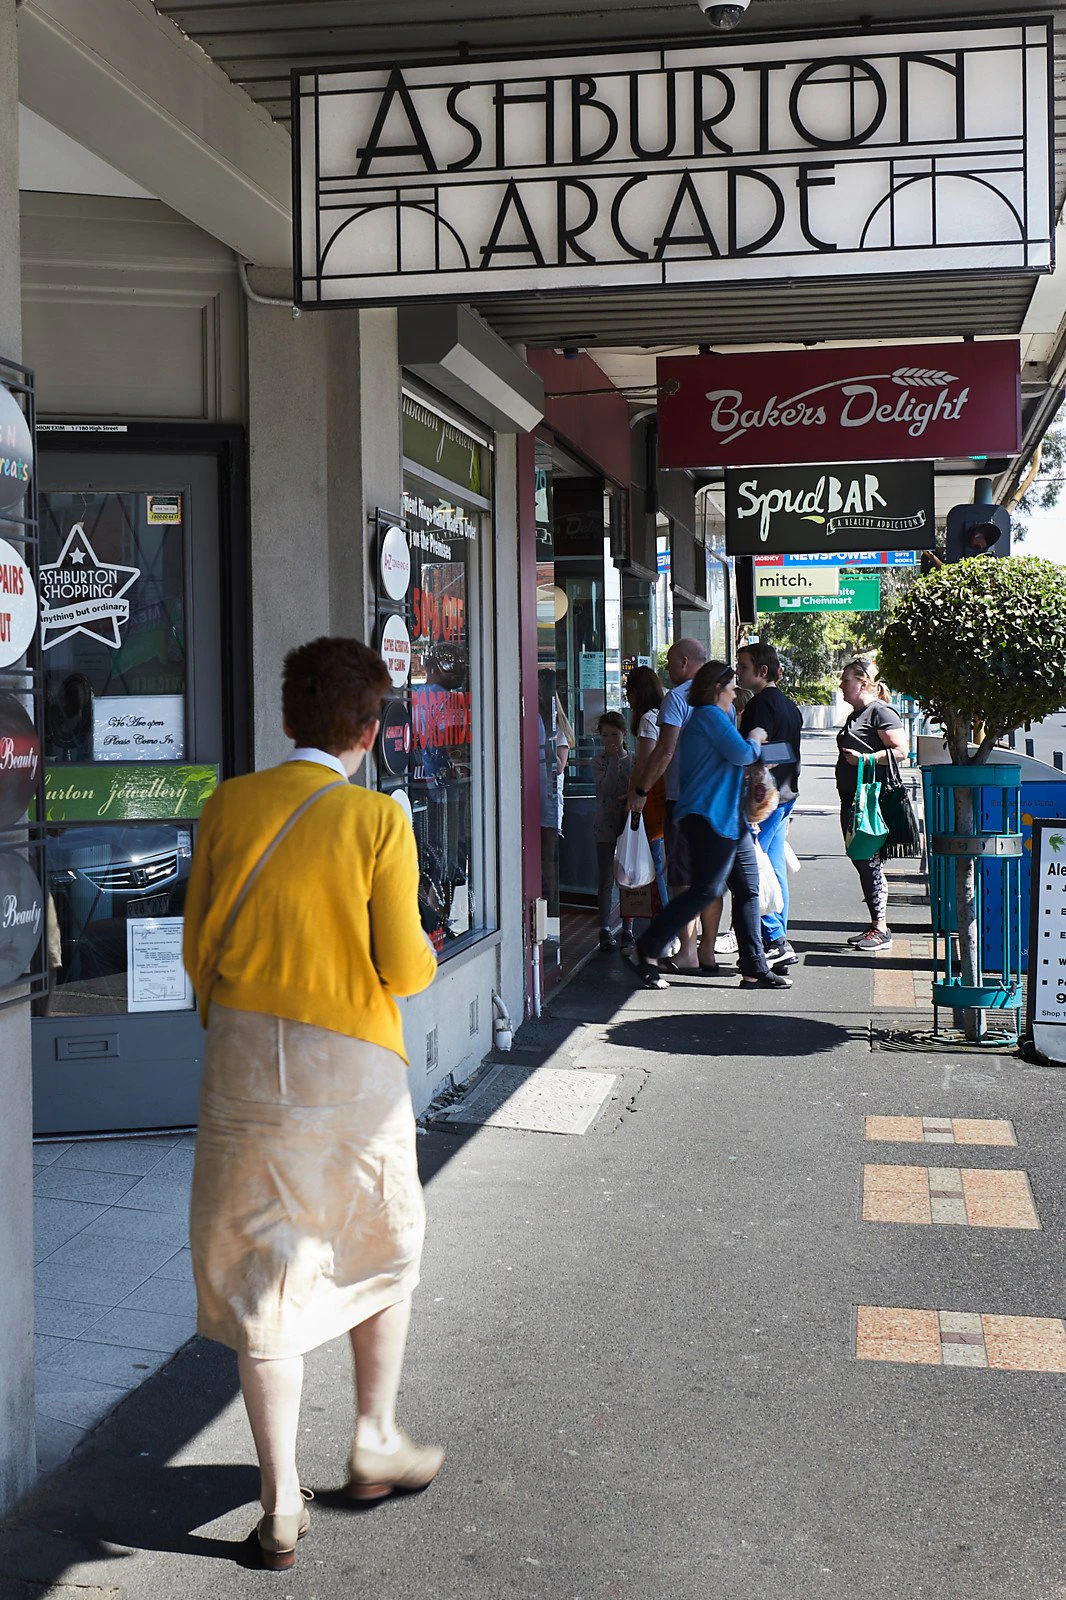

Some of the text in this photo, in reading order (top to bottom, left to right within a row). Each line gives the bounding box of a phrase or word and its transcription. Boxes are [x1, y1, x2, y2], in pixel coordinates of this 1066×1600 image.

[357, 52, 964, 176] ASHBURTON
[480, 163, 837, 269] ARCADE
[705, 384, 970, 445] Bakers Delight
[845, 518, 874, 527] HEALTHY
[877, 518, 918, 529] ADDICTION
[789, 551, 877, 561] NEWSPOWER
[40, 570, 117, 585] ASHBURTON
[760, 573, 812, 587] mitch.
[44, 584, 113, 599] SHOPPING
[803, 596, 852, 605] Chemmart
[75, 607, 90, 617] but
[91, 602, 127, 613] ordinary
[442, 593, 464, 644] OFF
[147, 719, 164, 730] open
[410, 691, 472, 750] TOREWIDE
[103, 733, 174, 746] Please Come In
[0, 737, 38, 780] Beauty
[97, 777, 188, 815] jewellery
[3, 895, 41, 934] Beauty
[1042, 1010, 1060, 1018] Shop
